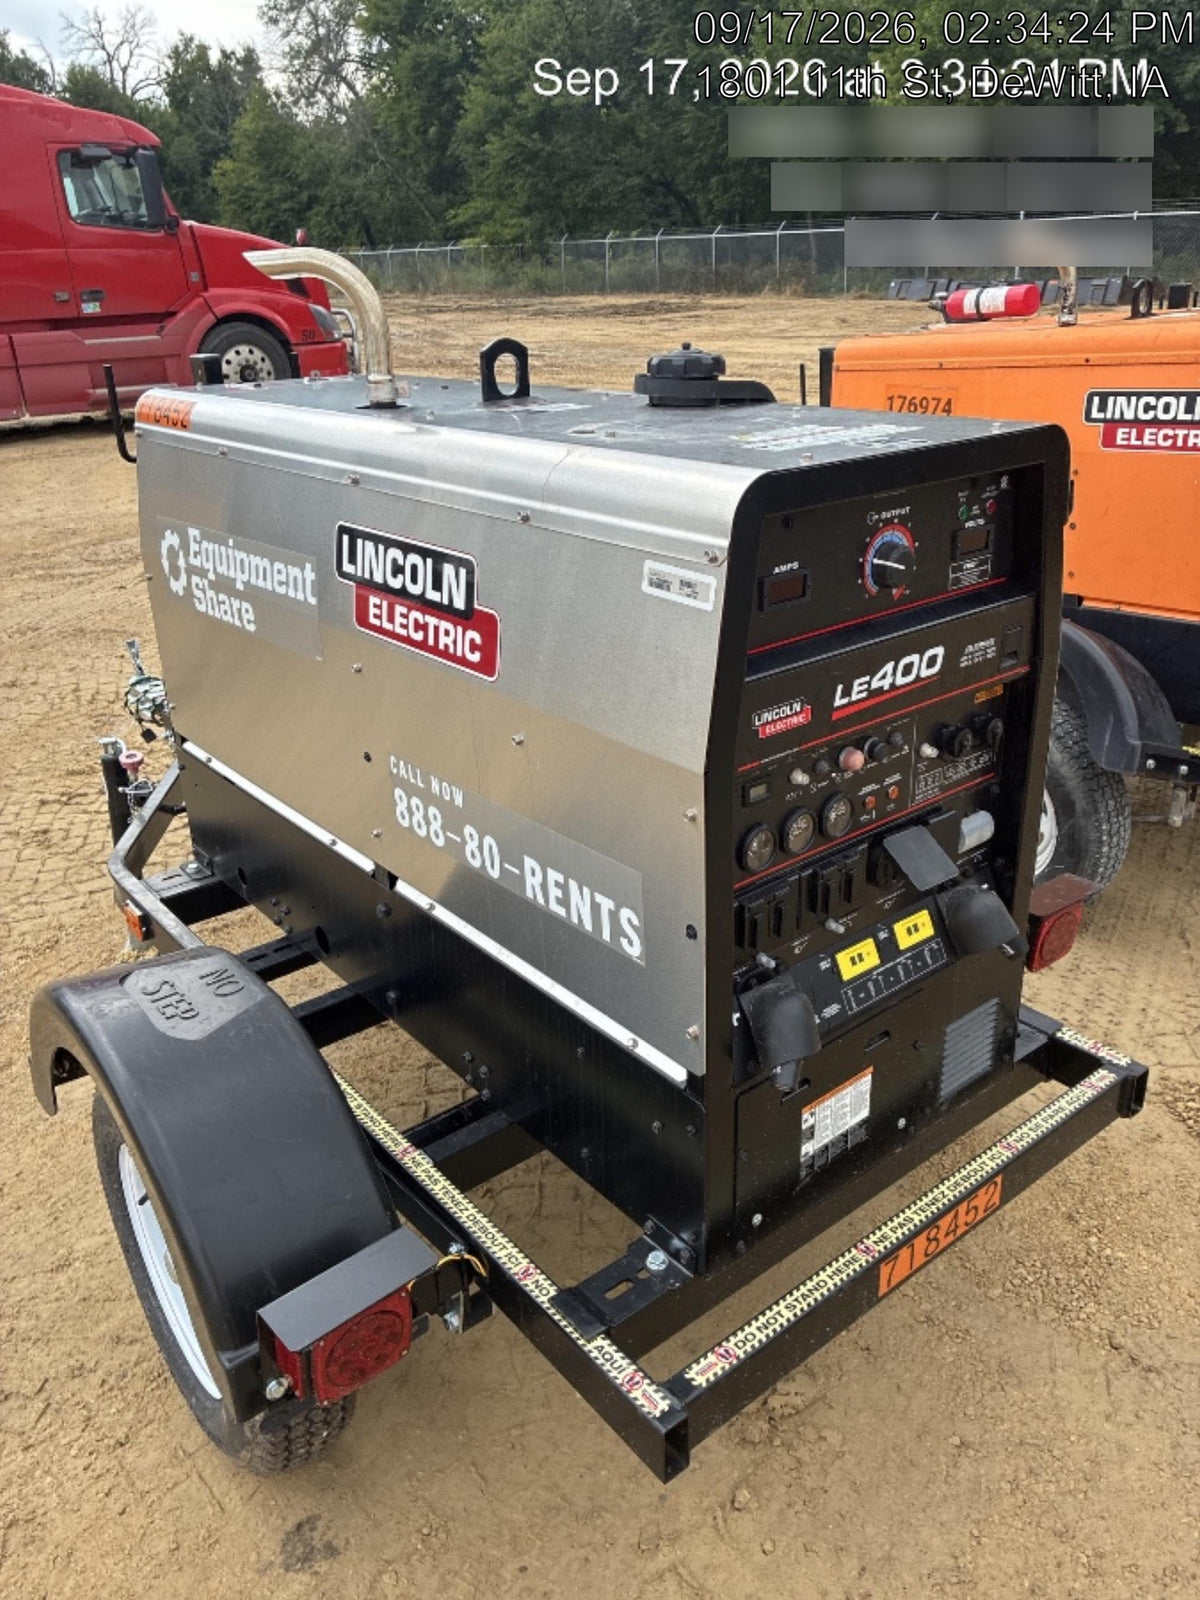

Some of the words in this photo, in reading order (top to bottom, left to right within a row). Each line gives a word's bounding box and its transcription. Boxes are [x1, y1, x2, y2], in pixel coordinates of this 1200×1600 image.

[887, 394, 952, 416] 176974
[187, 527, 317, 605] Equipment
[342, 533, 467, 611] LINCOLN
[773, 561, 799, 575] AMPS
[191, 573, 256, 632] Share
[368, 595, 482, 663] ELECTRIC
[833, 645, 945, 708] LE400
[754, 701, 802, 726] LINCOLN
[765, 714, 807, 737] ELECTRIC
[389, 755, 425, 788] CALL
[430, 775, 464, 808] NOW
[393, 787, 643, 959] 888-80-RENTS
[142, 980, 200, 1021] STEP
[199, 968, 245, 998] NO
[885, 1180, 1001, 1288] 718452
[465, 1211, 510, 1253] DEBOUT
[531, 1277, 551, 1298] NO
[593, 1343, 627, 1375] AQUI
[733, 1333, 758, 1350] DO
[757, 1310, 786, 1333] NOT
[785, 1278, 829, 1312] STAND
[829, 1252, 862, 1282] HERE
[890, 1214, 916, 1234] PAS
